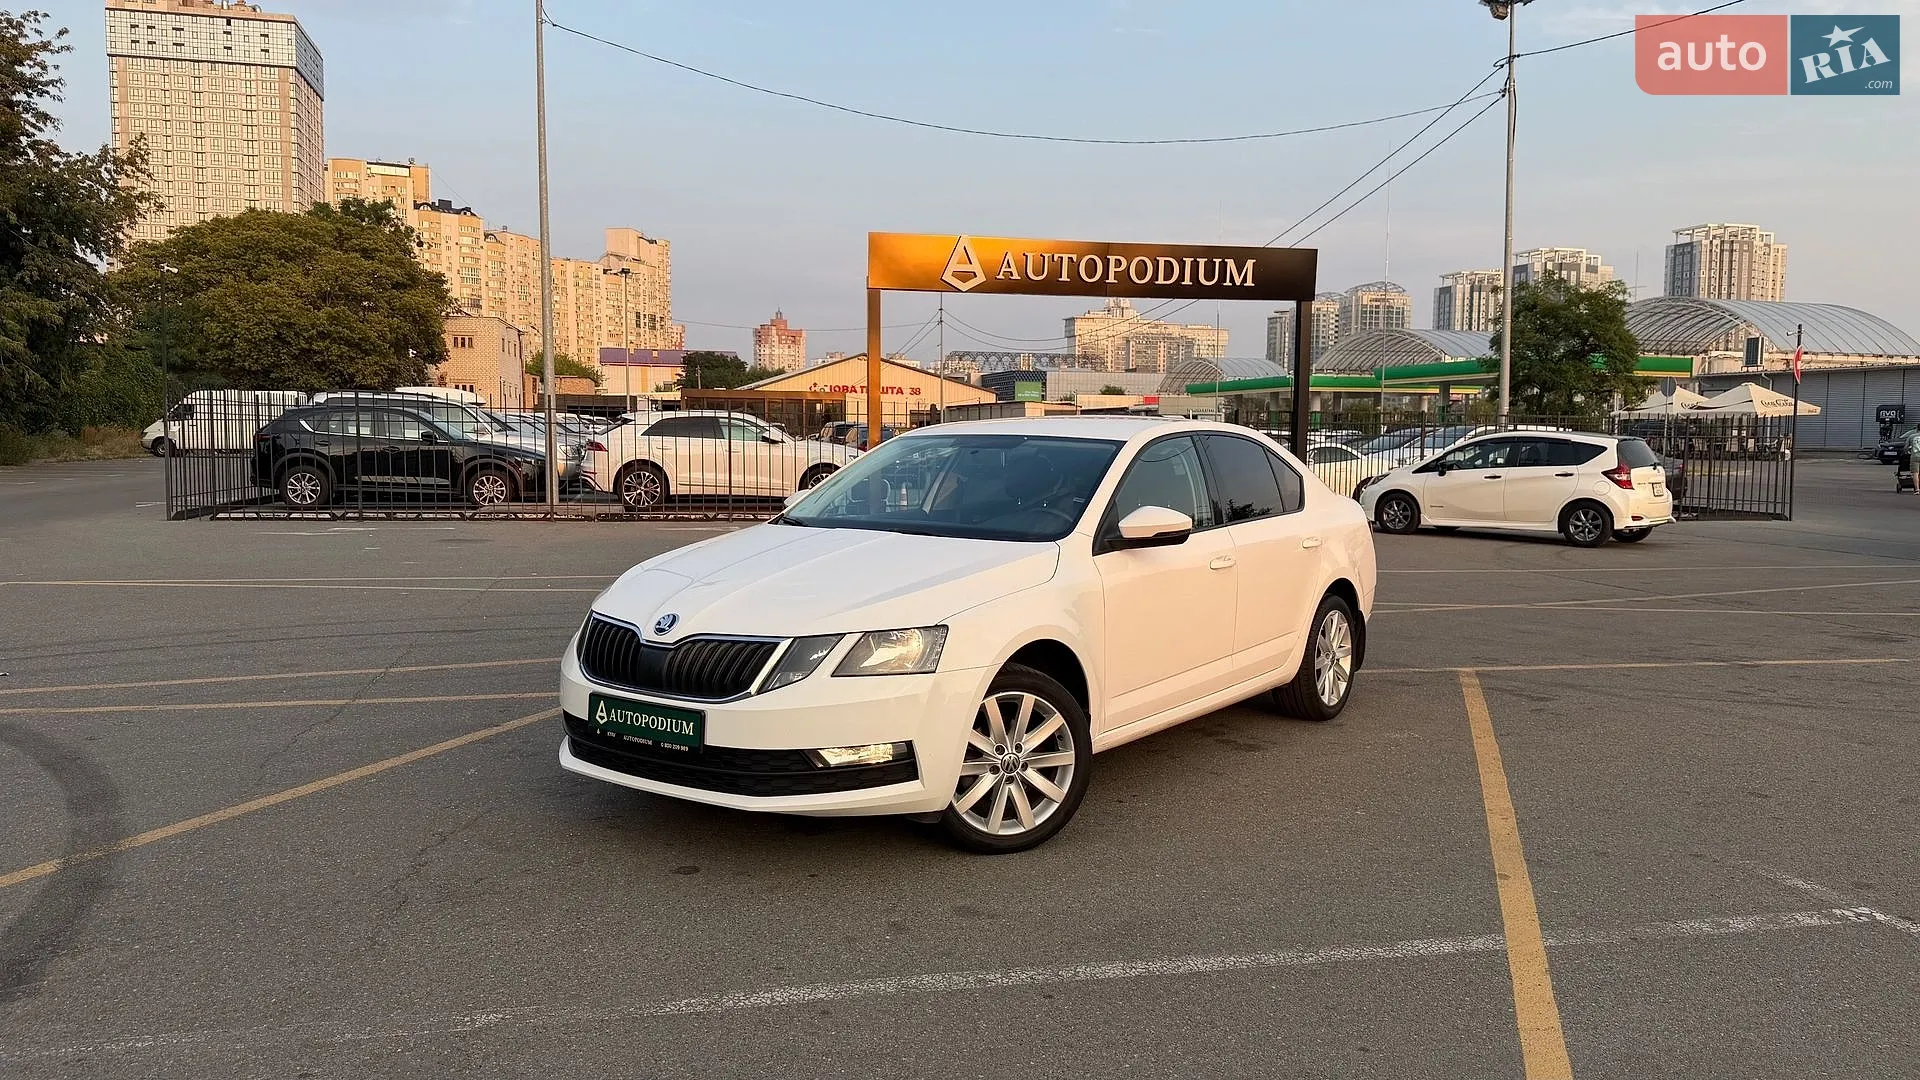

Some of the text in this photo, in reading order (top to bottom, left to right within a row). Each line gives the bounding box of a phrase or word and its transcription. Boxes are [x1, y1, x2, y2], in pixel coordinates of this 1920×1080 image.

[995, 252, 1256, 287] AUTOPODIUM
[909, 387, 921, 396] 38
[609, 709, 694, 736] AUTOPODIUM
